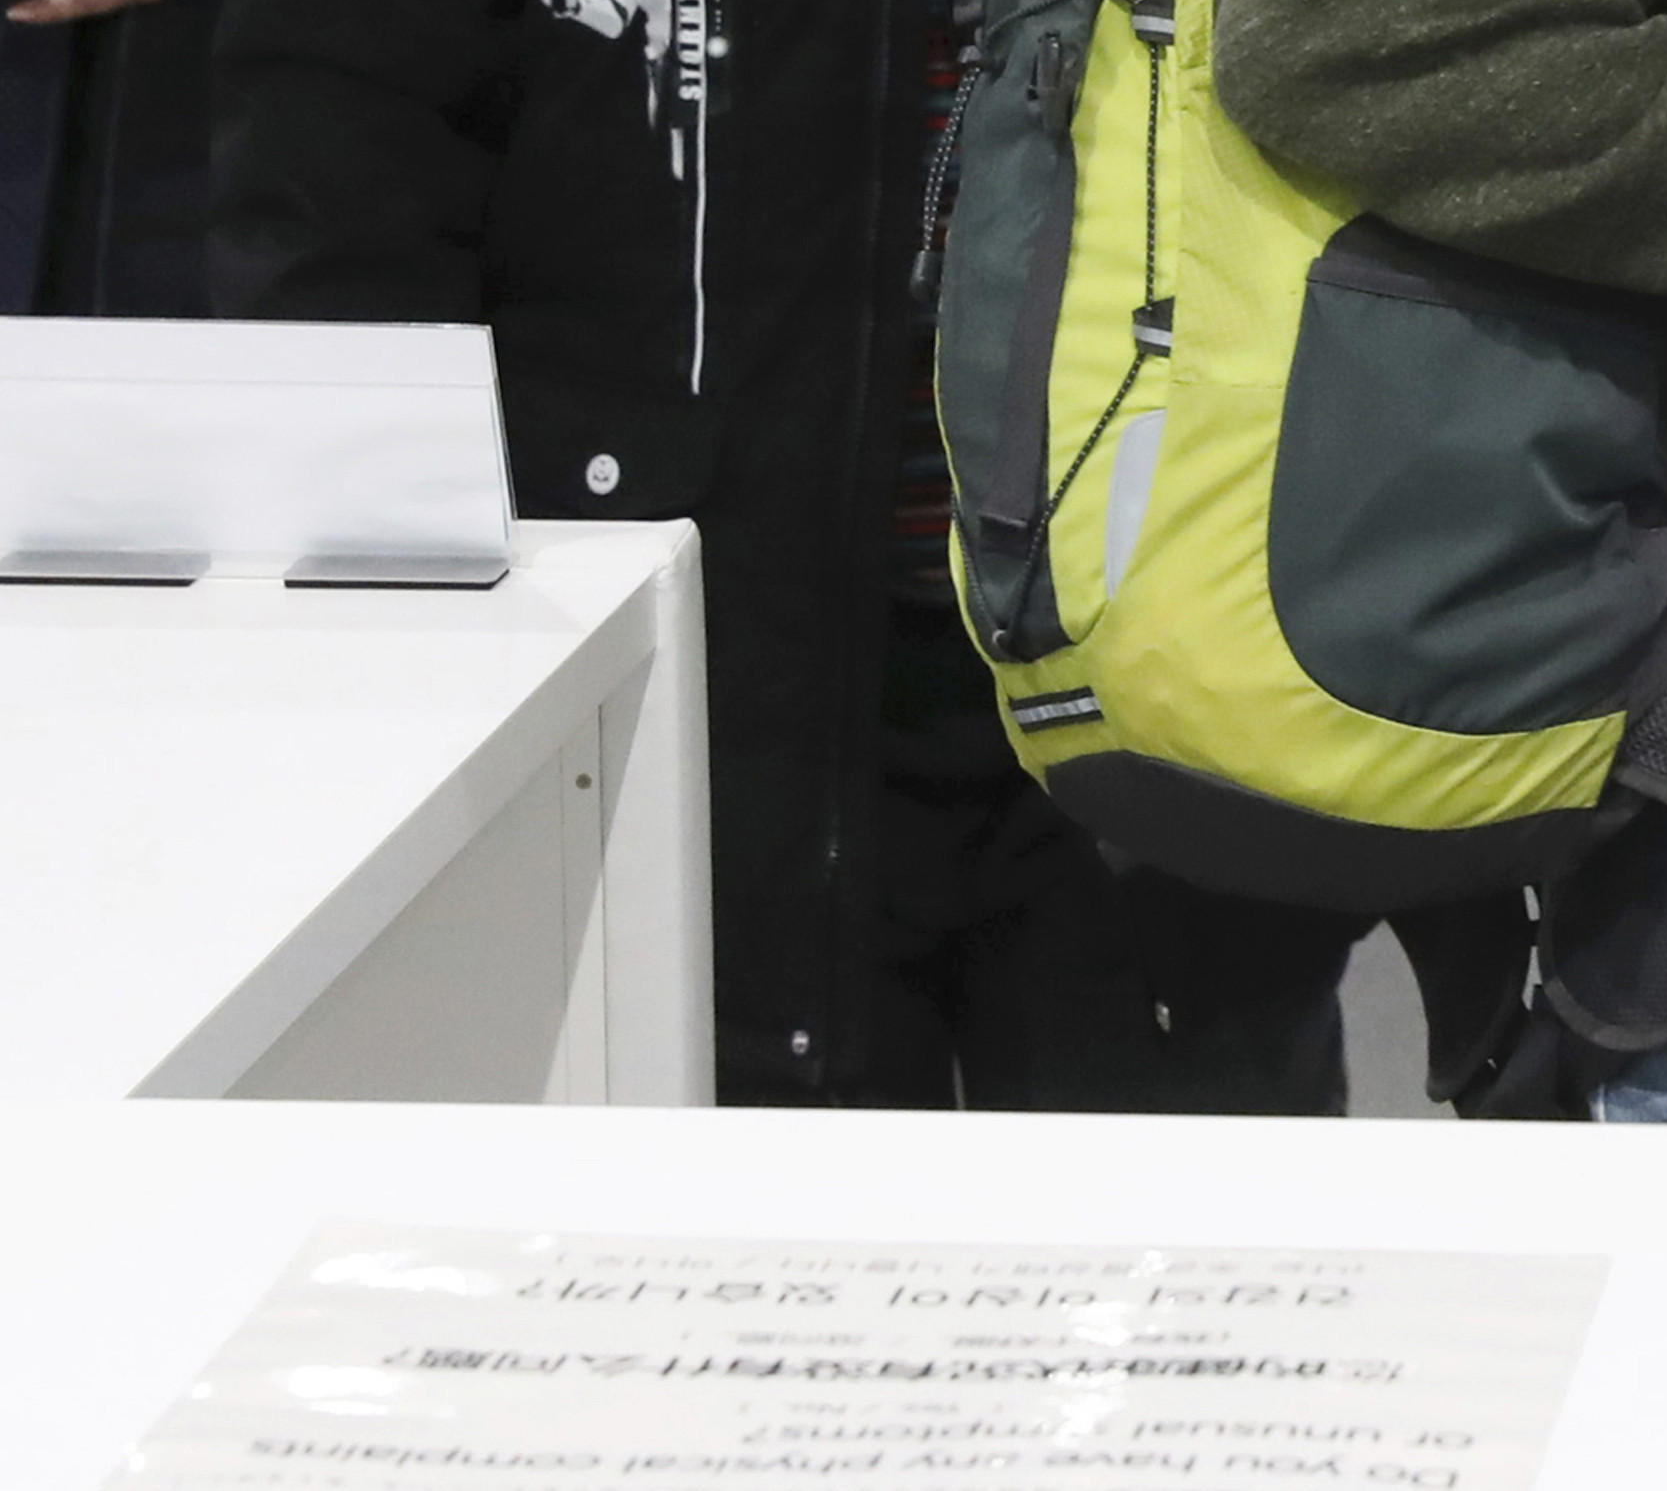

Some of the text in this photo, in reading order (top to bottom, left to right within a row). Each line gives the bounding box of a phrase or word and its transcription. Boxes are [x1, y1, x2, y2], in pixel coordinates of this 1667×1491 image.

[513, 1278, 840, 1308] 있습니까?
[740, 1417, 1475, 1452] or unusual smptoms?
[249, 1438, 1458, 1490] Do you have any physical complaints
